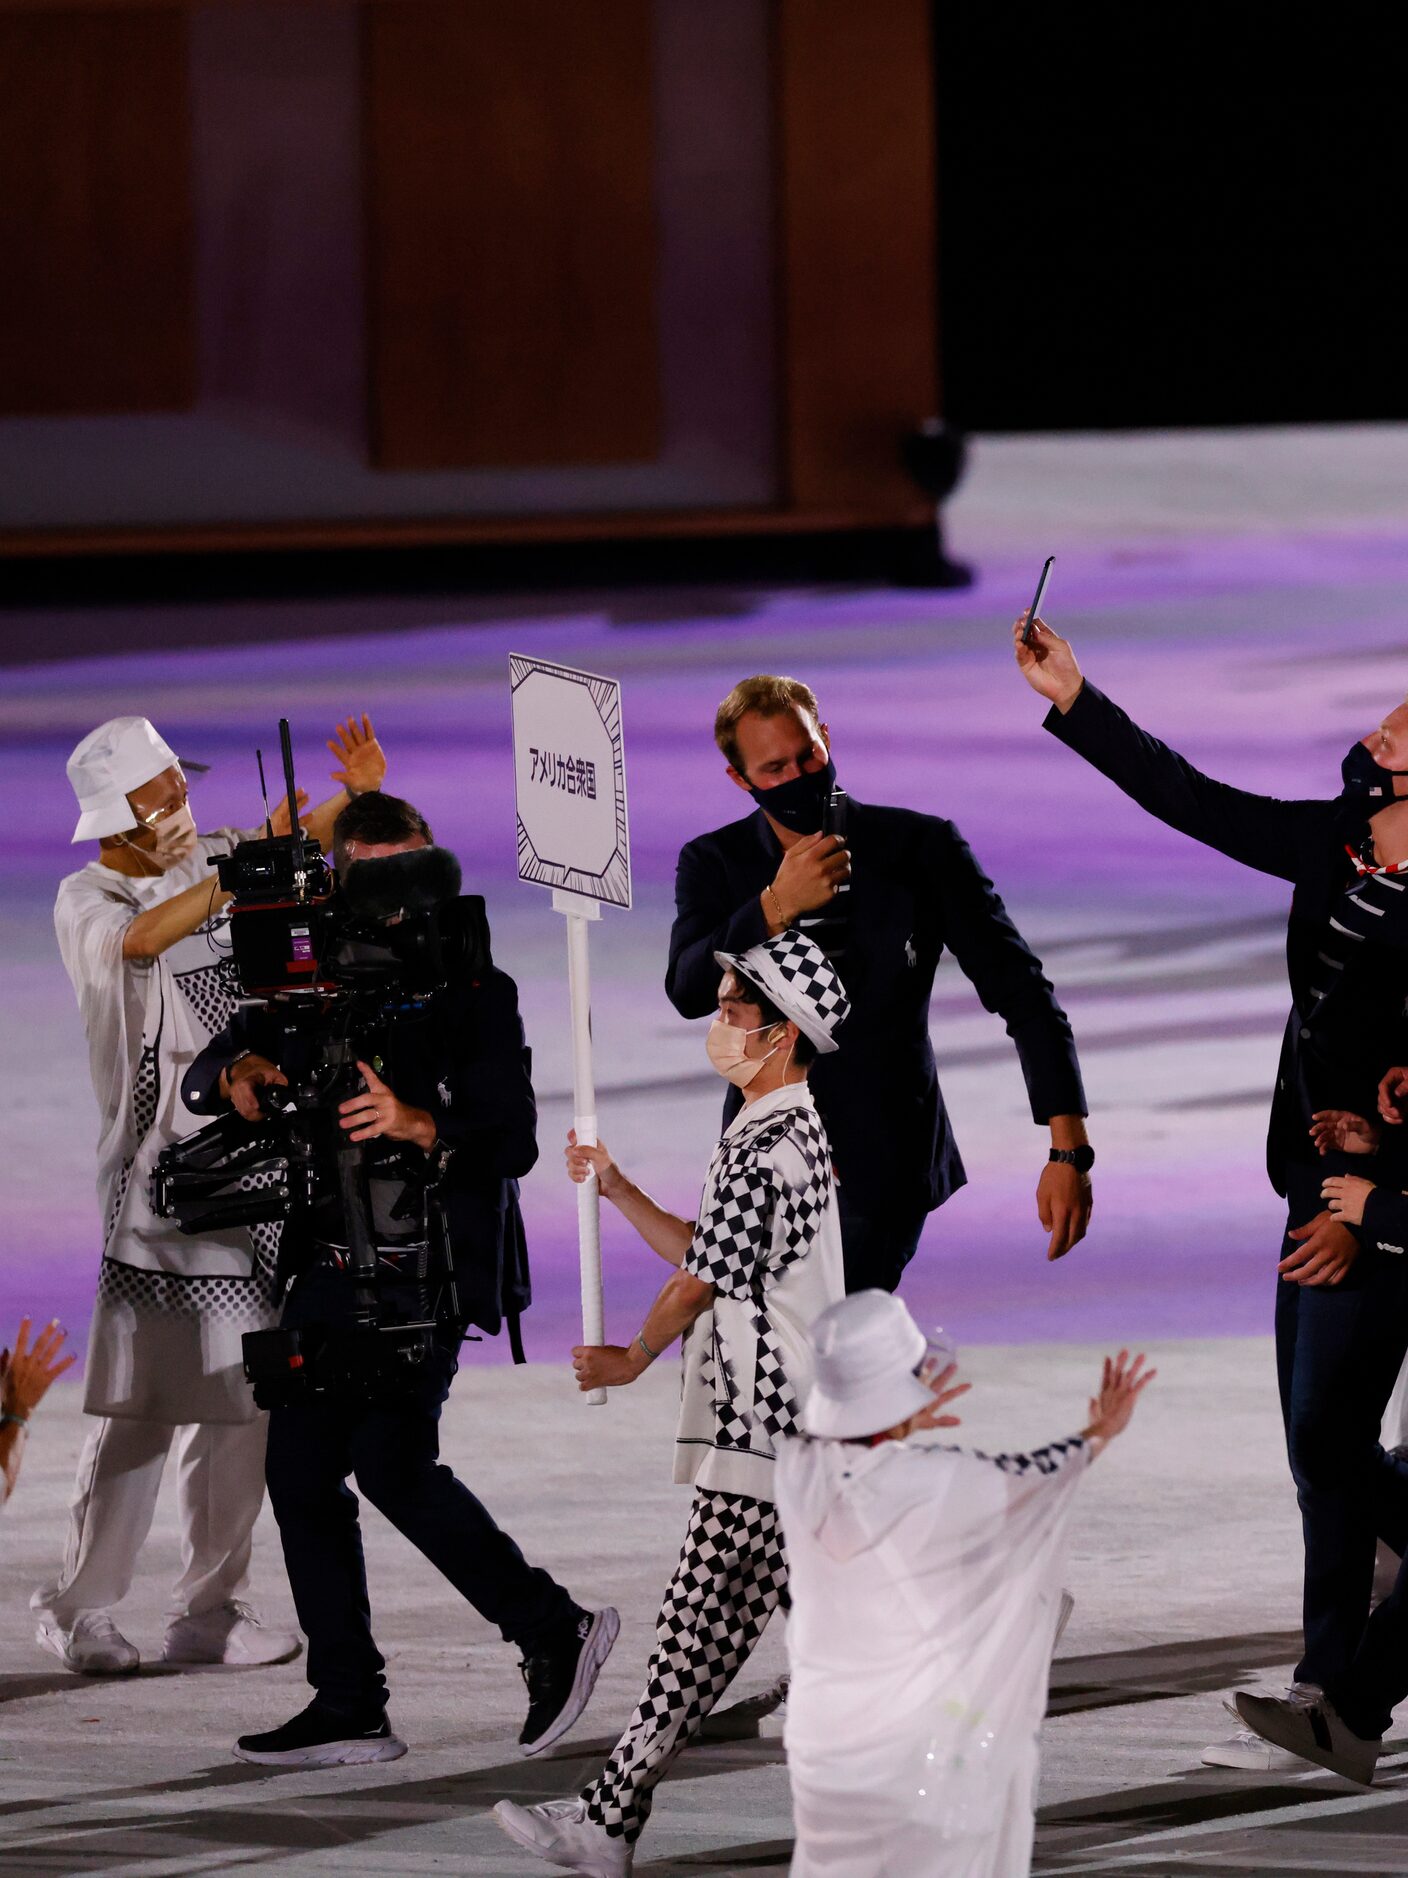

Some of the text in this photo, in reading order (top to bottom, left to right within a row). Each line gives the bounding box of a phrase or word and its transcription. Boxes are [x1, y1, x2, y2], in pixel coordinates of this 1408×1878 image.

[529, 748, 597, 801] アメリカ合衆国
